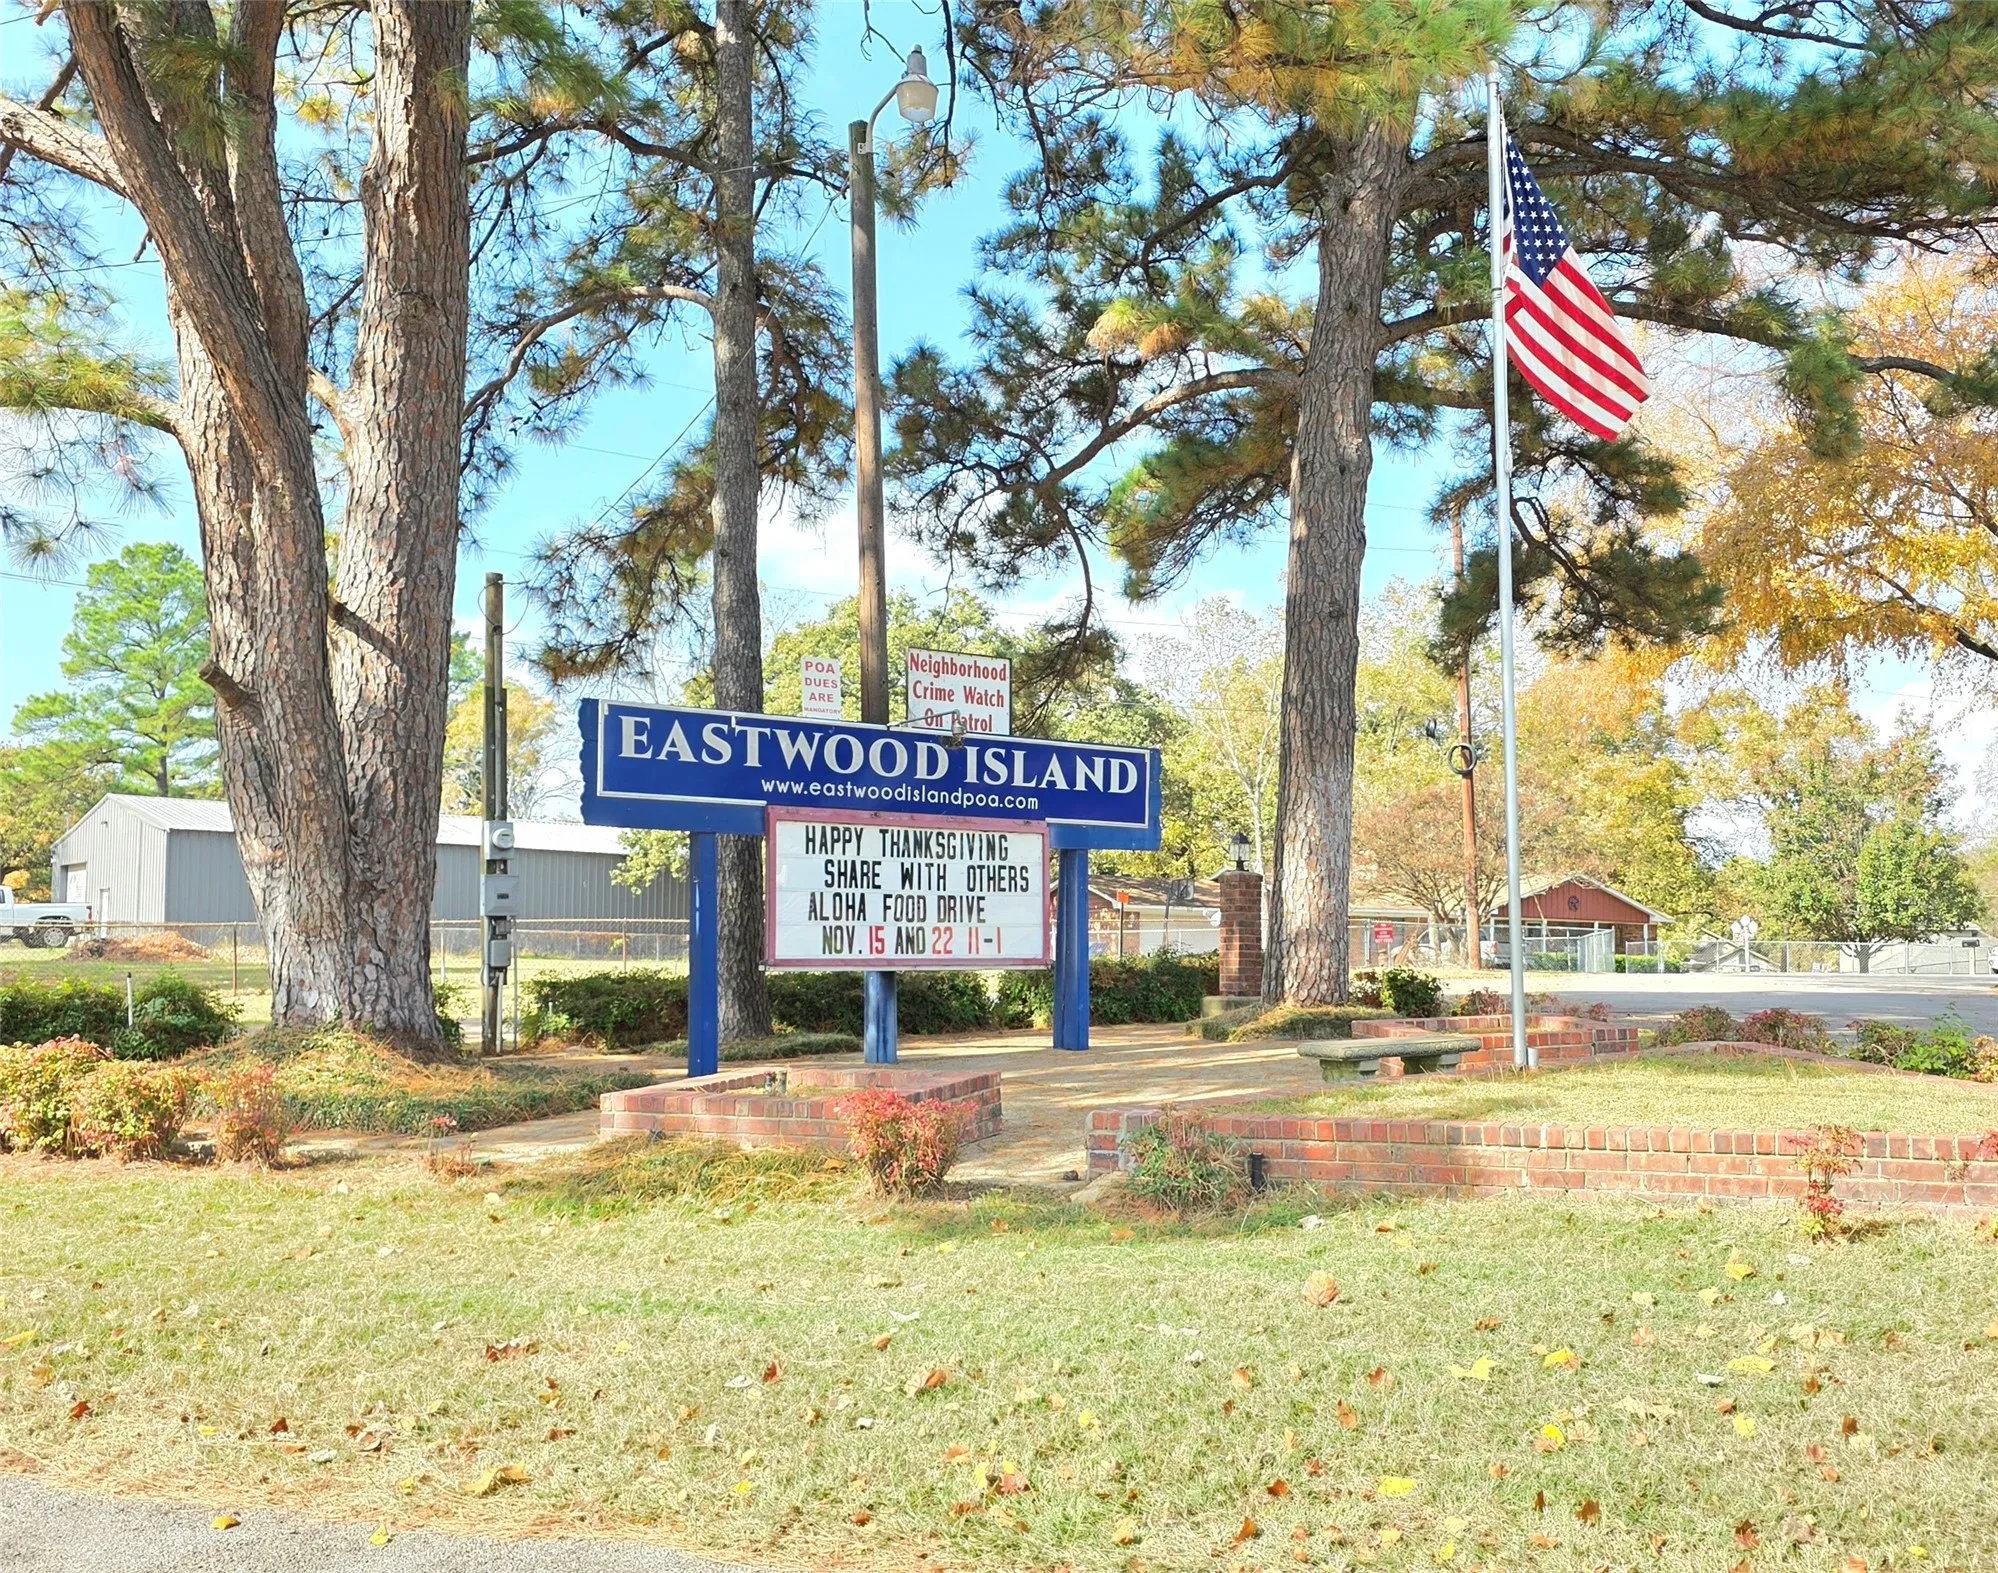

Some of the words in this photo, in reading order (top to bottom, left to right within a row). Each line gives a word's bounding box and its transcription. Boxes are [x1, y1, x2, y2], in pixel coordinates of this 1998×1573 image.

[805, 661, 835, 674] POA
[910, 652, 1006, 681] Neighborhood
[804, 677, 838, 689] DUES
[809, 692, 834, 703] ARE
[913, 680, 955, 702] Crime
[963, 685, 1004, 708] Watch
[924, 708, 943, 727] On
[618, 715, 949, 780] EASTWOOD
[963, 745, 1138, 794] ISLAND
[761, 779, 1039, 810] www.eastwoodislandpoa.com
[805, 825, 863, 856] HAPPY
[879, 828, 1008, 861] THANKSGIVING
[824, 859, 882, 889] SHARE
[901, 862, 947, 892] WITH
[967, 864, 1029, 892] OTHERS
[808, 891, 866, 921] ALOHA
[883, 894, 927, 923] FOOD
[937, 895, 986, 923] DRIVE
[822, 925, 862, 954] NOV.
[869, 926, 885, 954] 15
[894, 926, 926, 954] AND
[932, 926, 953, 954] 22
[968, 927, 1001, 954] 11-1
